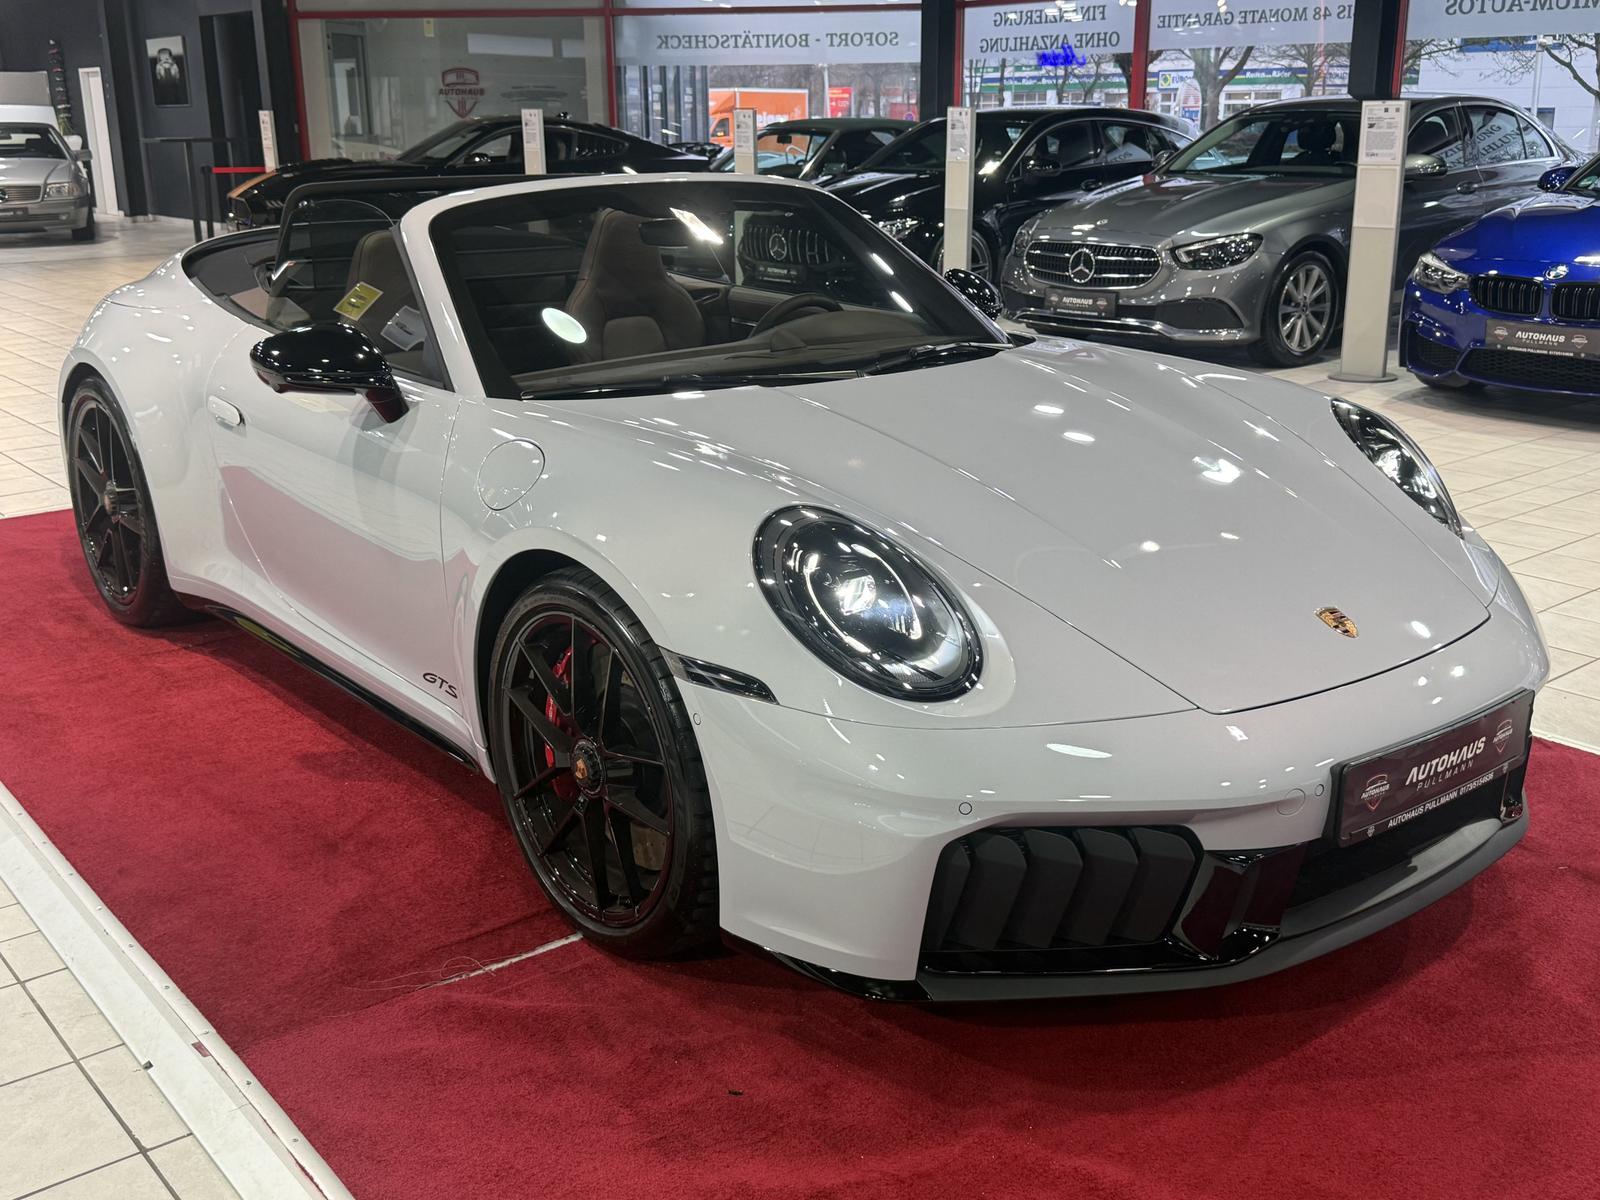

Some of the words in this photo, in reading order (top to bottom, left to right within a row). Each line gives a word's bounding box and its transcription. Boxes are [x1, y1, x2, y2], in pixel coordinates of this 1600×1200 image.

[438, 87, 485, 96] AUTOHAUS
[1515, 330, 1566, 343] AUTOHAUS
[422, 672, 458, 699] GTS
[1404, 736, 1487, 786] AUTOHAUS
[1416, 759, 1474, 791] PULLMANN
[1387, 805, 1425, 828] AUTOHAUS
[1424, 790, 1459, 812] PULLMANN
